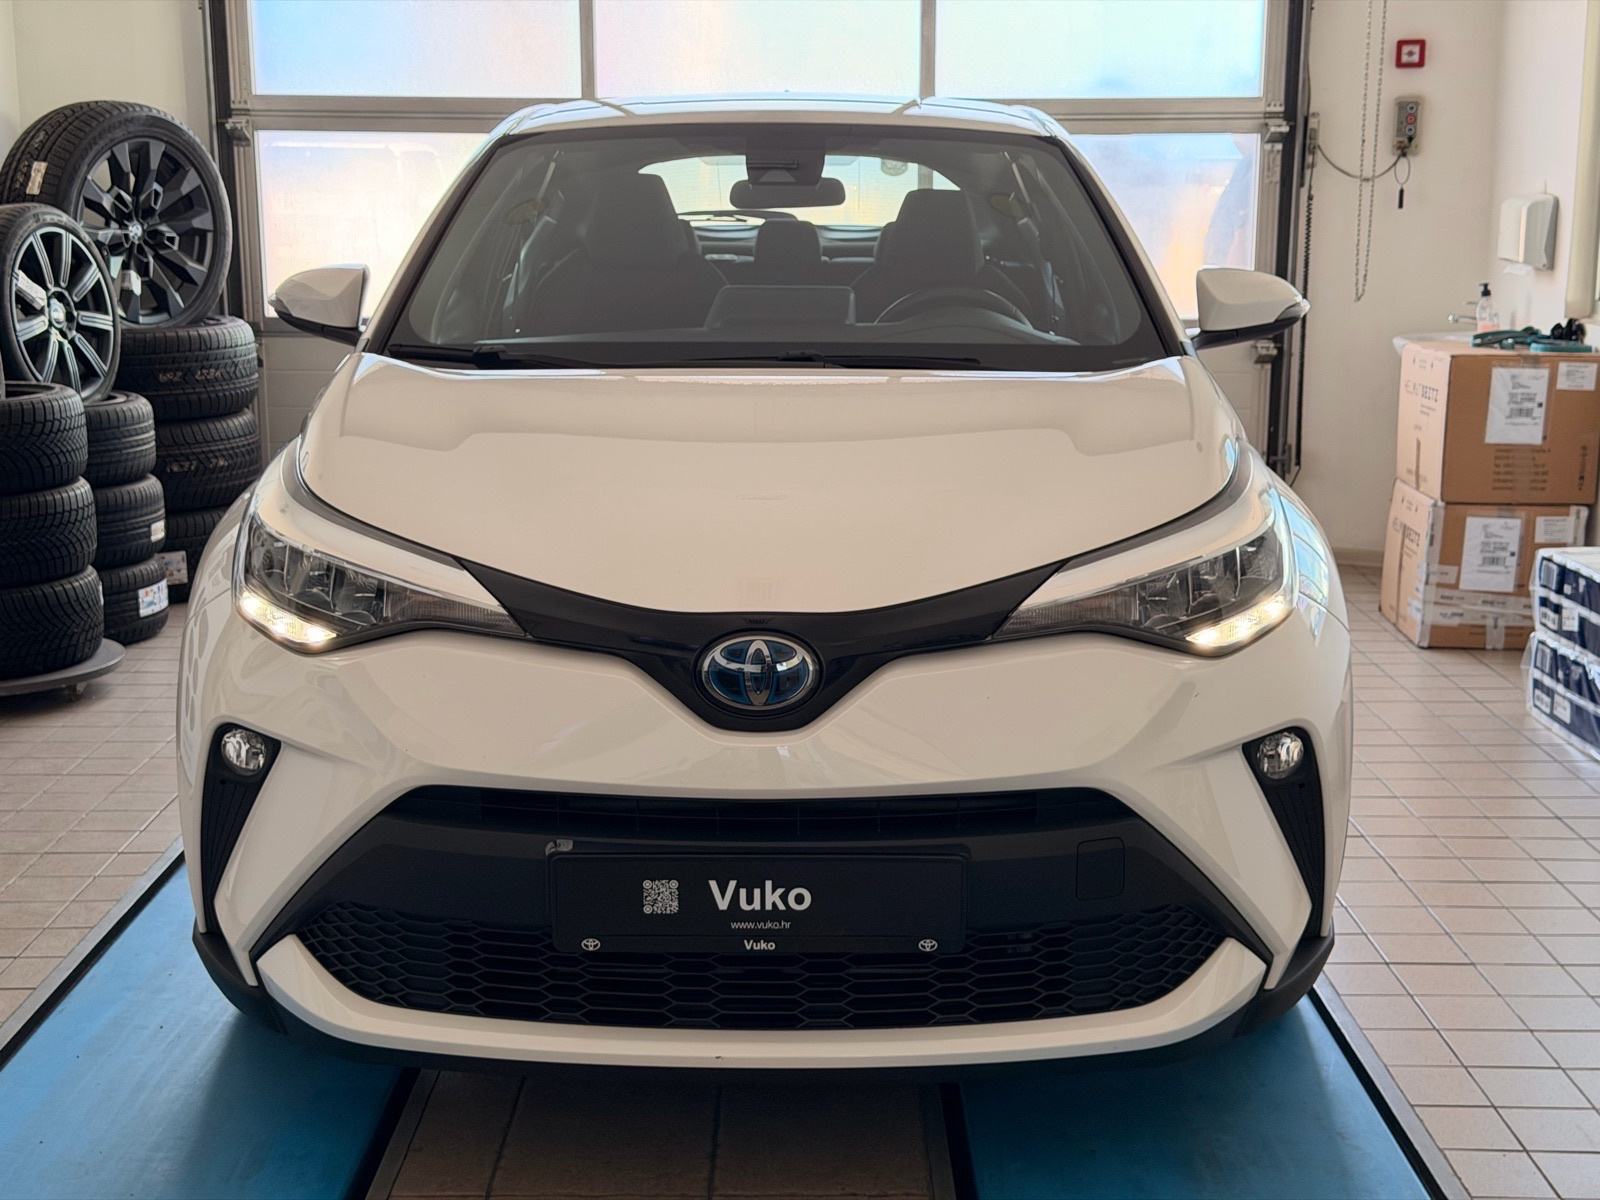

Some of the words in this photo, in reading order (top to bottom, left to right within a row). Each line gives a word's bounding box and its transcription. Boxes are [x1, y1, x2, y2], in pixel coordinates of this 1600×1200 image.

[708, 879, 812, 911] Vuko
[731, 920, 790, 930] www.vuko.hr
[743, 939, 776, 951] Vuko
